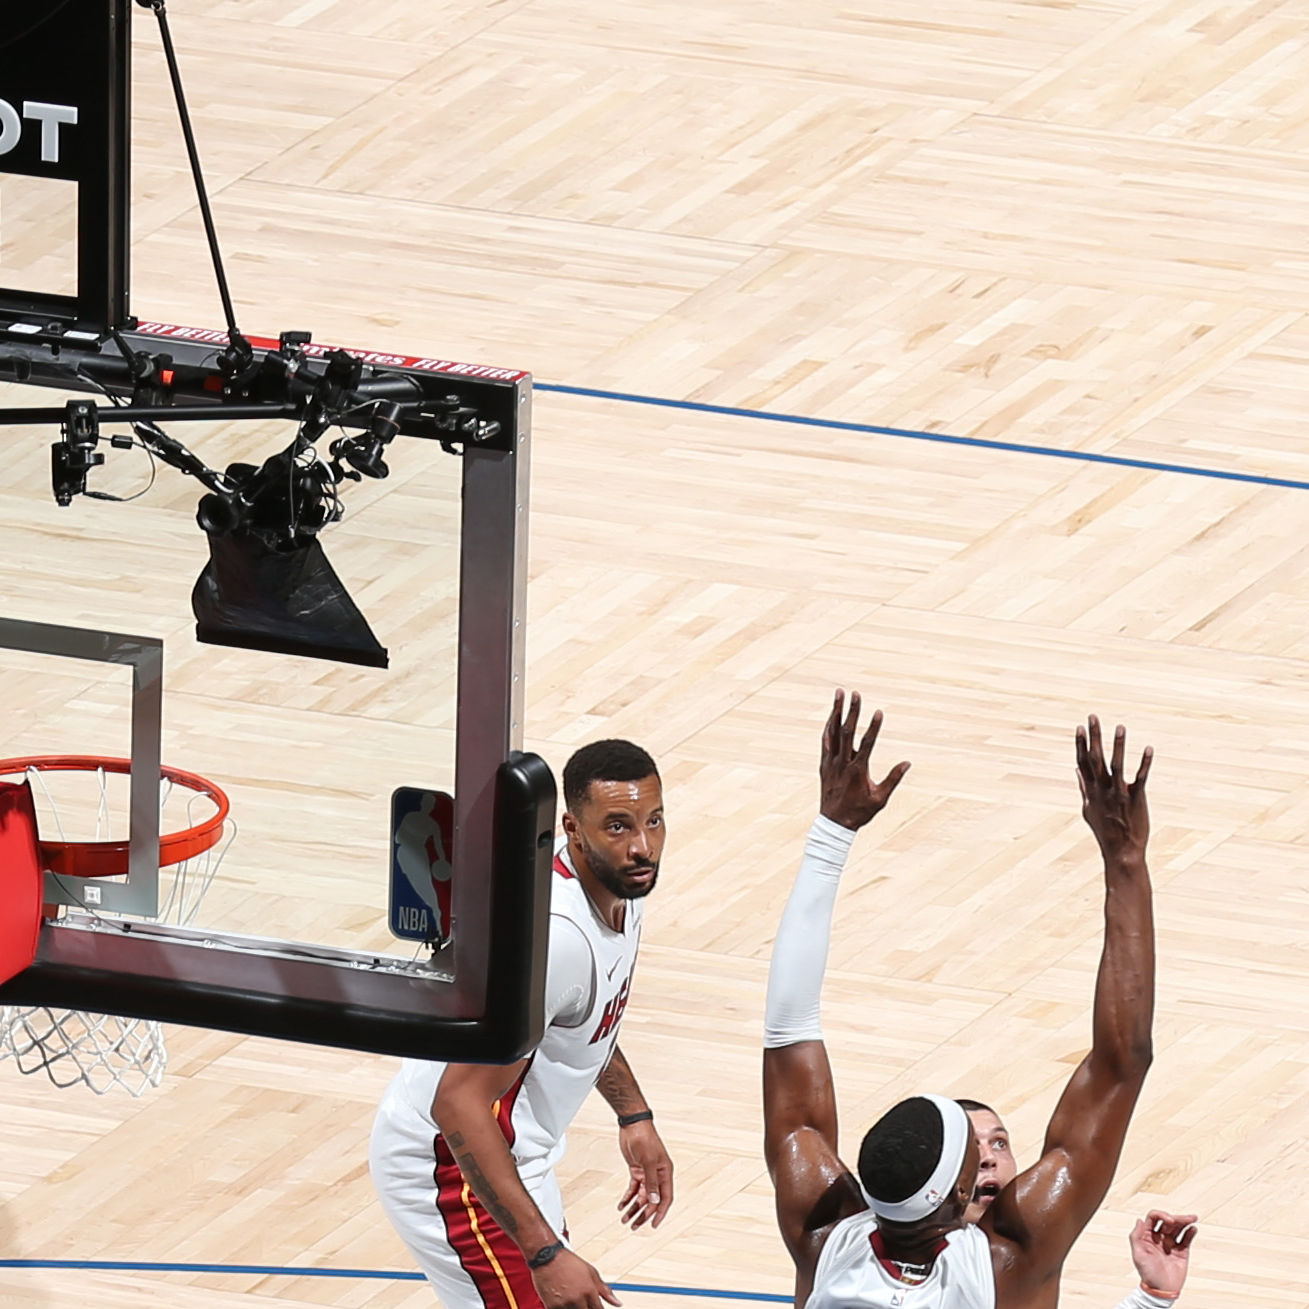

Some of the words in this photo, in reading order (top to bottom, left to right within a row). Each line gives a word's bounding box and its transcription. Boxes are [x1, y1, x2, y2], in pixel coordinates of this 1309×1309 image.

[171, 326, 231, 343] BETTE
[412, 359, 452, 370] FLY
[447, 363, 521, 380] BETTER
[398, 906, 429, 932] NBA
